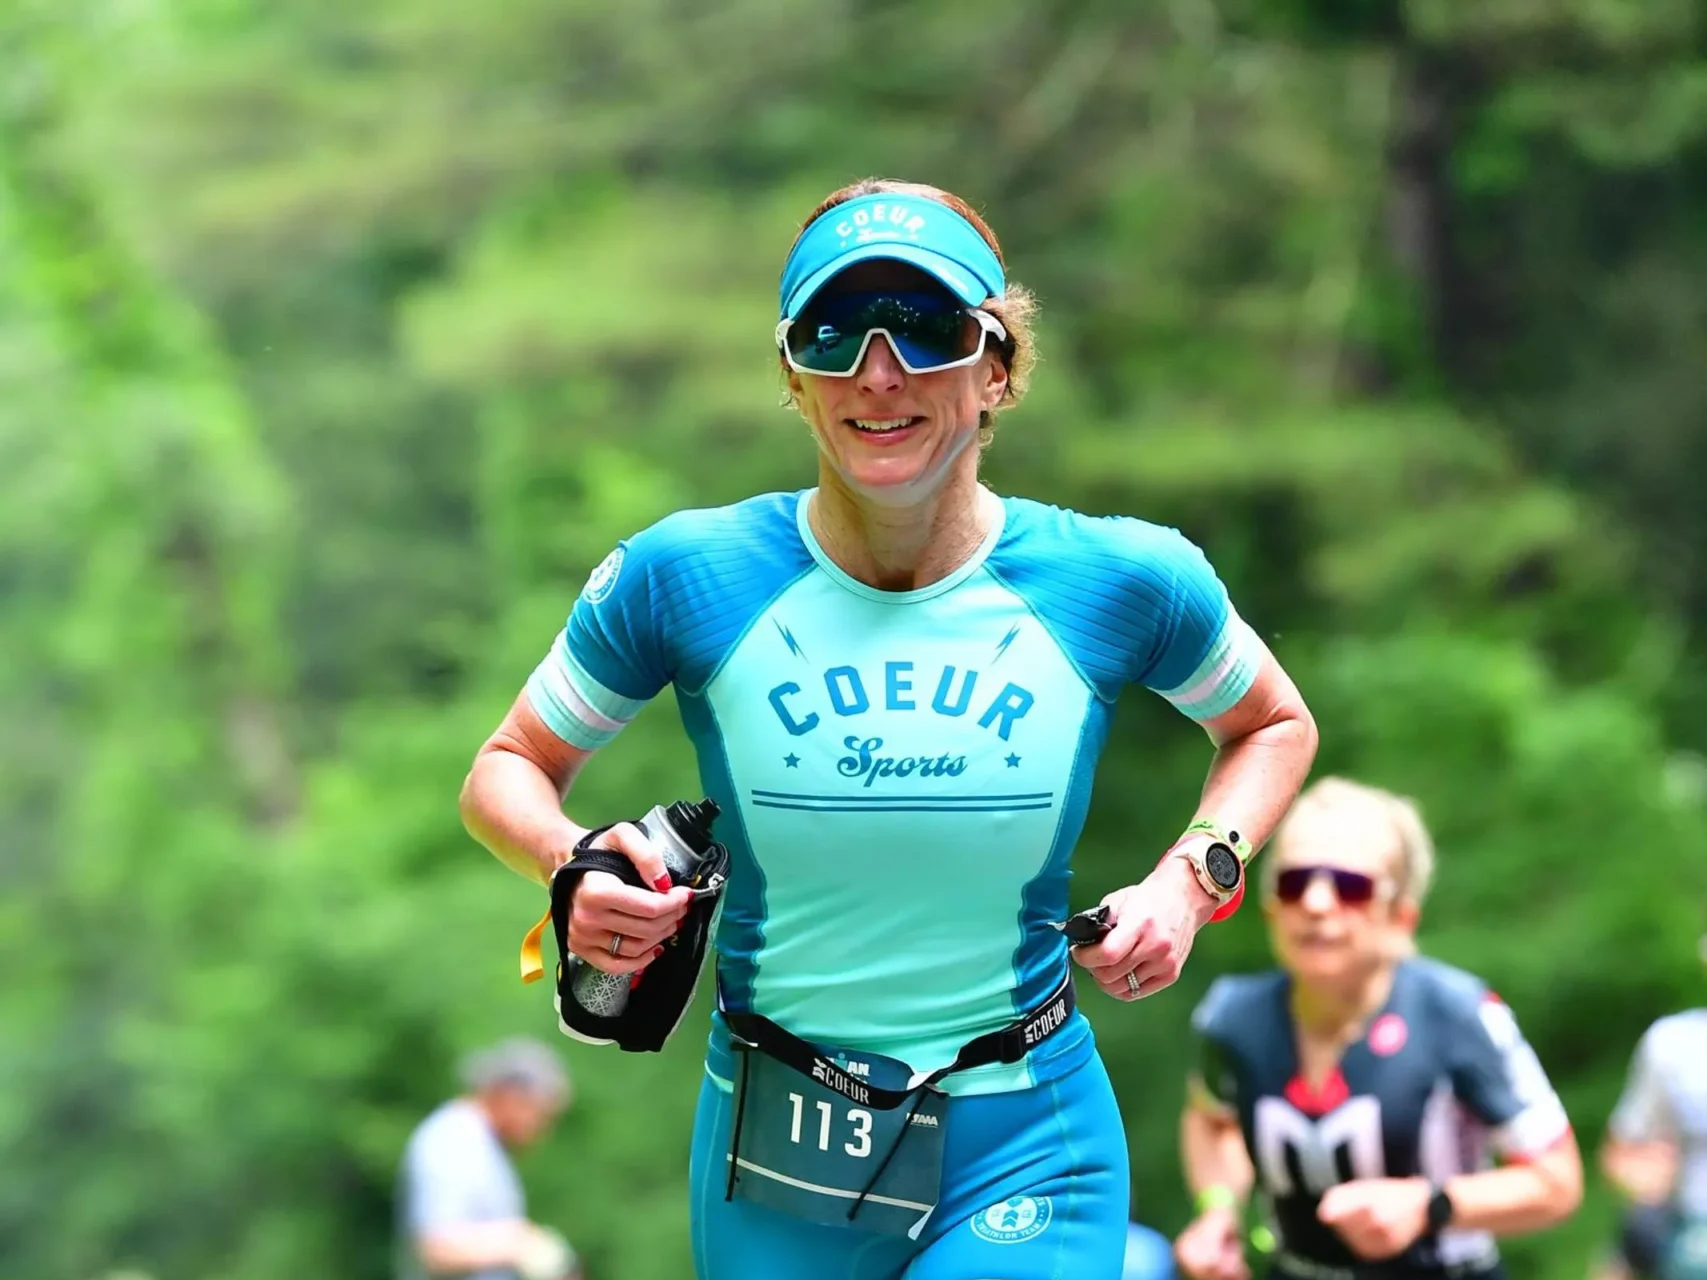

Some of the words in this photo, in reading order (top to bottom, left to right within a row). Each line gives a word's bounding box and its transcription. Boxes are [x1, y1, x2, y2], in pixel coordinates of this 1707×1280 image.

[836, 203, 926, 238] COEUR
[768, 661, 1035, 742] COEUR
[837, 735, 968, 787] Sports
[1033, 998, 1067, 1041] COEUR
[825, 1066, 869, 1104] COEUR
[789, 1092, 873, 1158] 113
